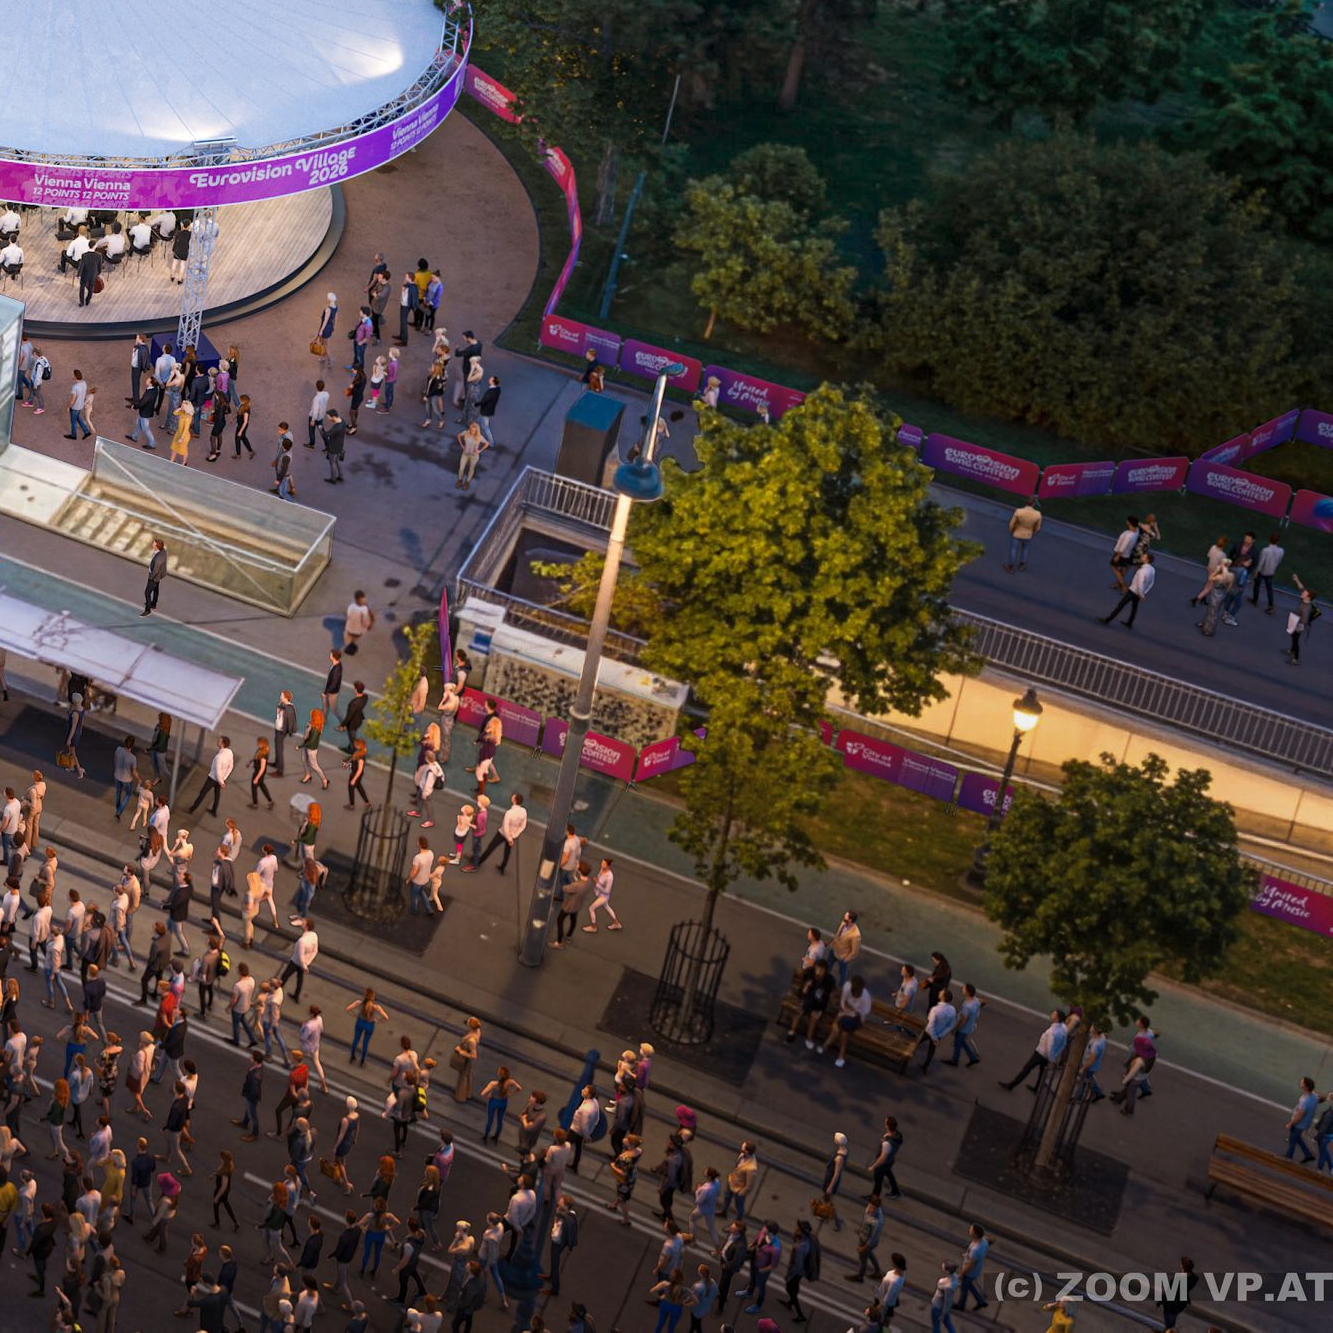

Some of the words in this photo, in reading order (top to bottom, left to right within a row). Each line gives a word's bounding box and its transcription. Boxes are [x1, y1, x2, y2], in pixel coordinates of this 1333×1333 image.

[189, 163, 293, 188] Eurovision
[295, 146, 357, 172] Village
[309, 164, 349, 186] 2026
[34, 173, 81, 189] Vienna
[83, 177, 131, 191] Vienna
[33, 186, 43, 196] 12
[44, 188, 81, 199] POINTS
[82, 190, 93, 200] 12
[93, 192, 130, 201] POINTS
[945, 448, 1021, 476] EUROVISION
[945, 454, 973, 467] SONG
[973, 462, 1017, 482] CONTEST
[1128, 464, 1177, 478] EUROVISION
[1128, 474, 1145, 483] SONG
[1145, 472, 1174, 481] CONTEST
[1207, 472, 1275, 497] EUROVISION
[1207, 478, 1231, 492] SONG
[1231, 484, 1271, 503] CONTEST
[861, 753, 891, 768] Vienna
[862, 748, 879, 762] City
[881, 754, 892, 762] of
[903, 756, 929, 772] Vienna
[929, 766, 957, 780] Vienna
[1263, 884, 1309, 908] United
[1271, 898, 1311, 918] Music
